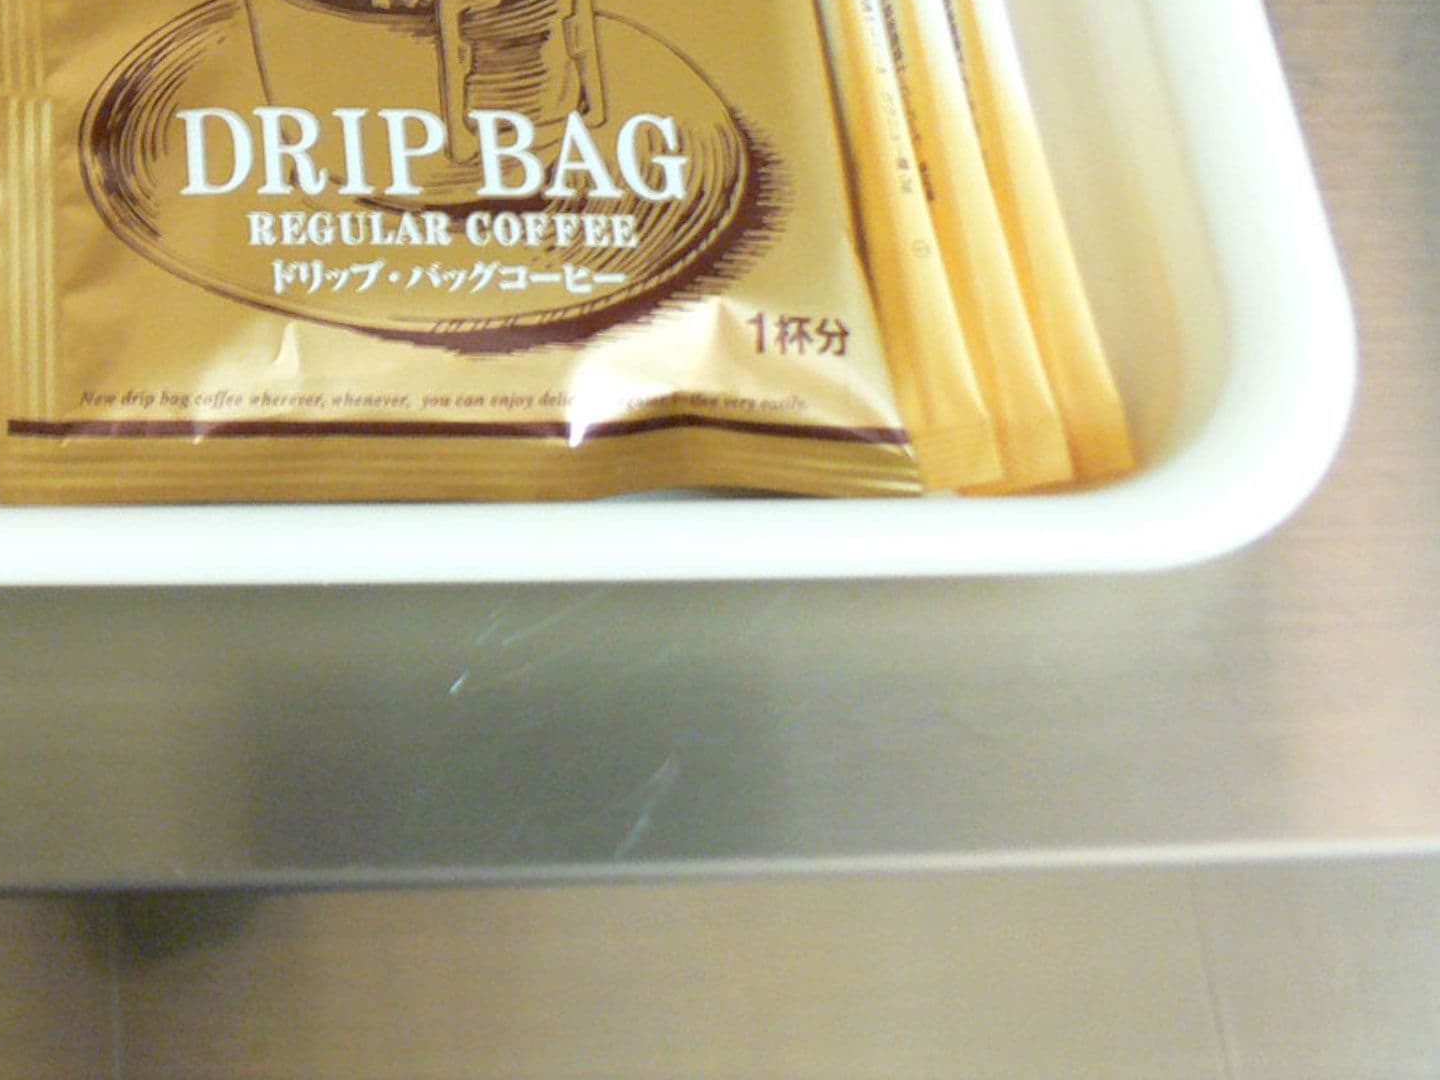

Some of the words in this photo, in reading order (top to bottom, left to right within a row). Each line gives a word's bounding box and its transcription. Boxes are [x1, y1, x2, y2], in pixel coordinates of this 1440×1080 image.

[176, 105, 447, 196] DRIP
[468, 107, 690, 201] BAG
[246, 210, 453, 249] REGULAR
[464, 210, 640, 250] COFFEE
[746, 311, 850, 357] 1杯分
[119, 389, 156, 410] drip
[159, 389, 191, 410] bag
[194, 389, 245, 410] coffee
[421, 393, 452, 410] you
[455, 393, 486, 408] can
